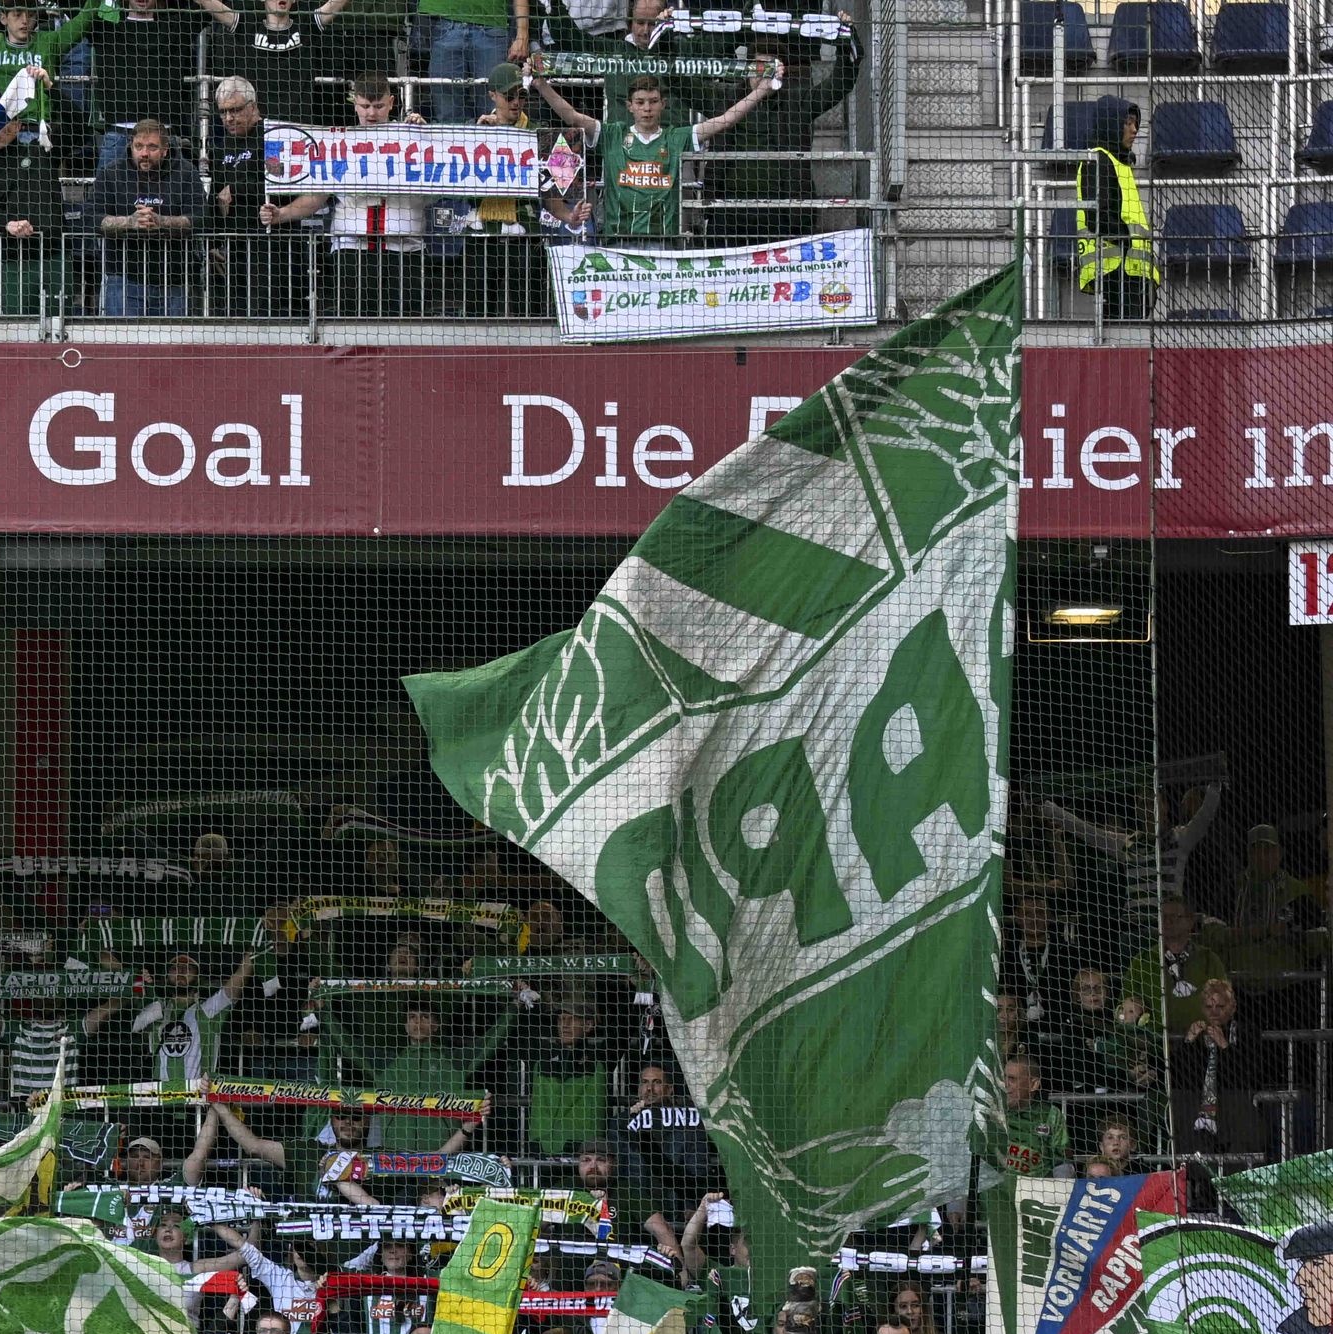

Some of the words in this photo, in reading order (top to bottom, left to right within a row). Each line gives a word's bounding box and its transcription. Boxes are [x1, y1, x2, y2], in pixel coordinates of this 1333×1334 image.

[619, 174, 671, 187] ENERGIE
[629, 163, 661, 175] WIEN
[605, 290, 650, 313] LOVE
[657, 288, 698, 310] BEER
[729, 285, 769, 303] HATE
[773, 281, 812, 303] RB
[28, 391, 311, 488] Goal
[502, 394, 694, 489] Die
[496, 957, 554, 969] WIEN
[564, 956, 621, 969] WEST
[67, 970, 130, 986] WIEN
[211, 1079, 265, 1097] Immer
[270, 1081, 331, 1105] fröhlich
[375, 1088, 427, 1112] Rapid
[432, 1091, 476, 1114] Wien
[378, 1155, 446, 1174] RAPID
[1040, 1180, 1122, 1326] VORWÄRTS
